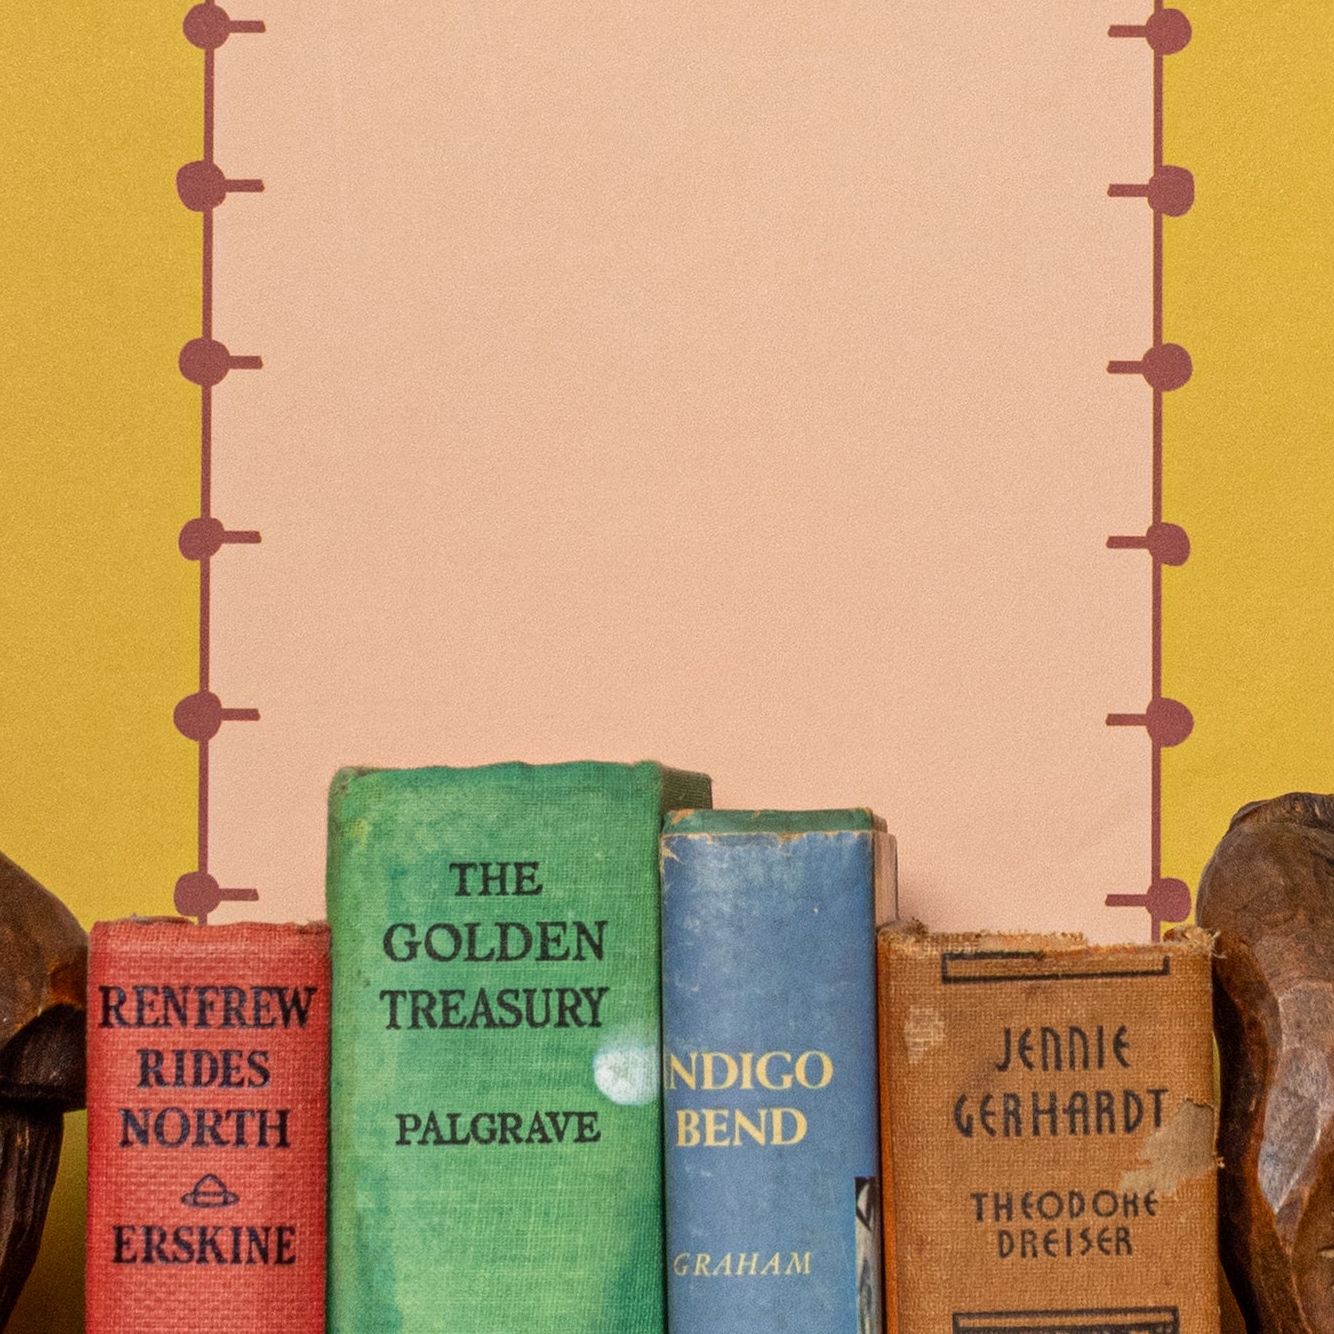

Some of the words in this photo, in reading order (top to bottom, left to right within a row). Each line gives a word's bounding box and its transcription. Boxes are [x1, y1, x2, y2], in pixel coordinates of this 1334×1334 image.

[450, 862, 543, 896] THE
[382, 921, 608, 963] GOLDEN
[99, 986, 317, 1030] RENFREW
[380, 987, 610, 1030] TREASURY
[996, 1025, 1131, 1071] JENNIE
[137, 1049, 271, 1088] RIDES
[669, 1051, 834, 1091] NDIGO
[119, 1107, 290, 1148] NORTH
[395, 1111, 602, 1145] PALGRAVE
[675, 1107, 808, 1147] BEND
[954, 1089, 1168, 1137] GERHARDT
[112, 1226, 296, 1265] ERSKINE
[998, 1226, 1133, 1258] DREISER
[673, 1251, 811, 1277] GRAHAM
